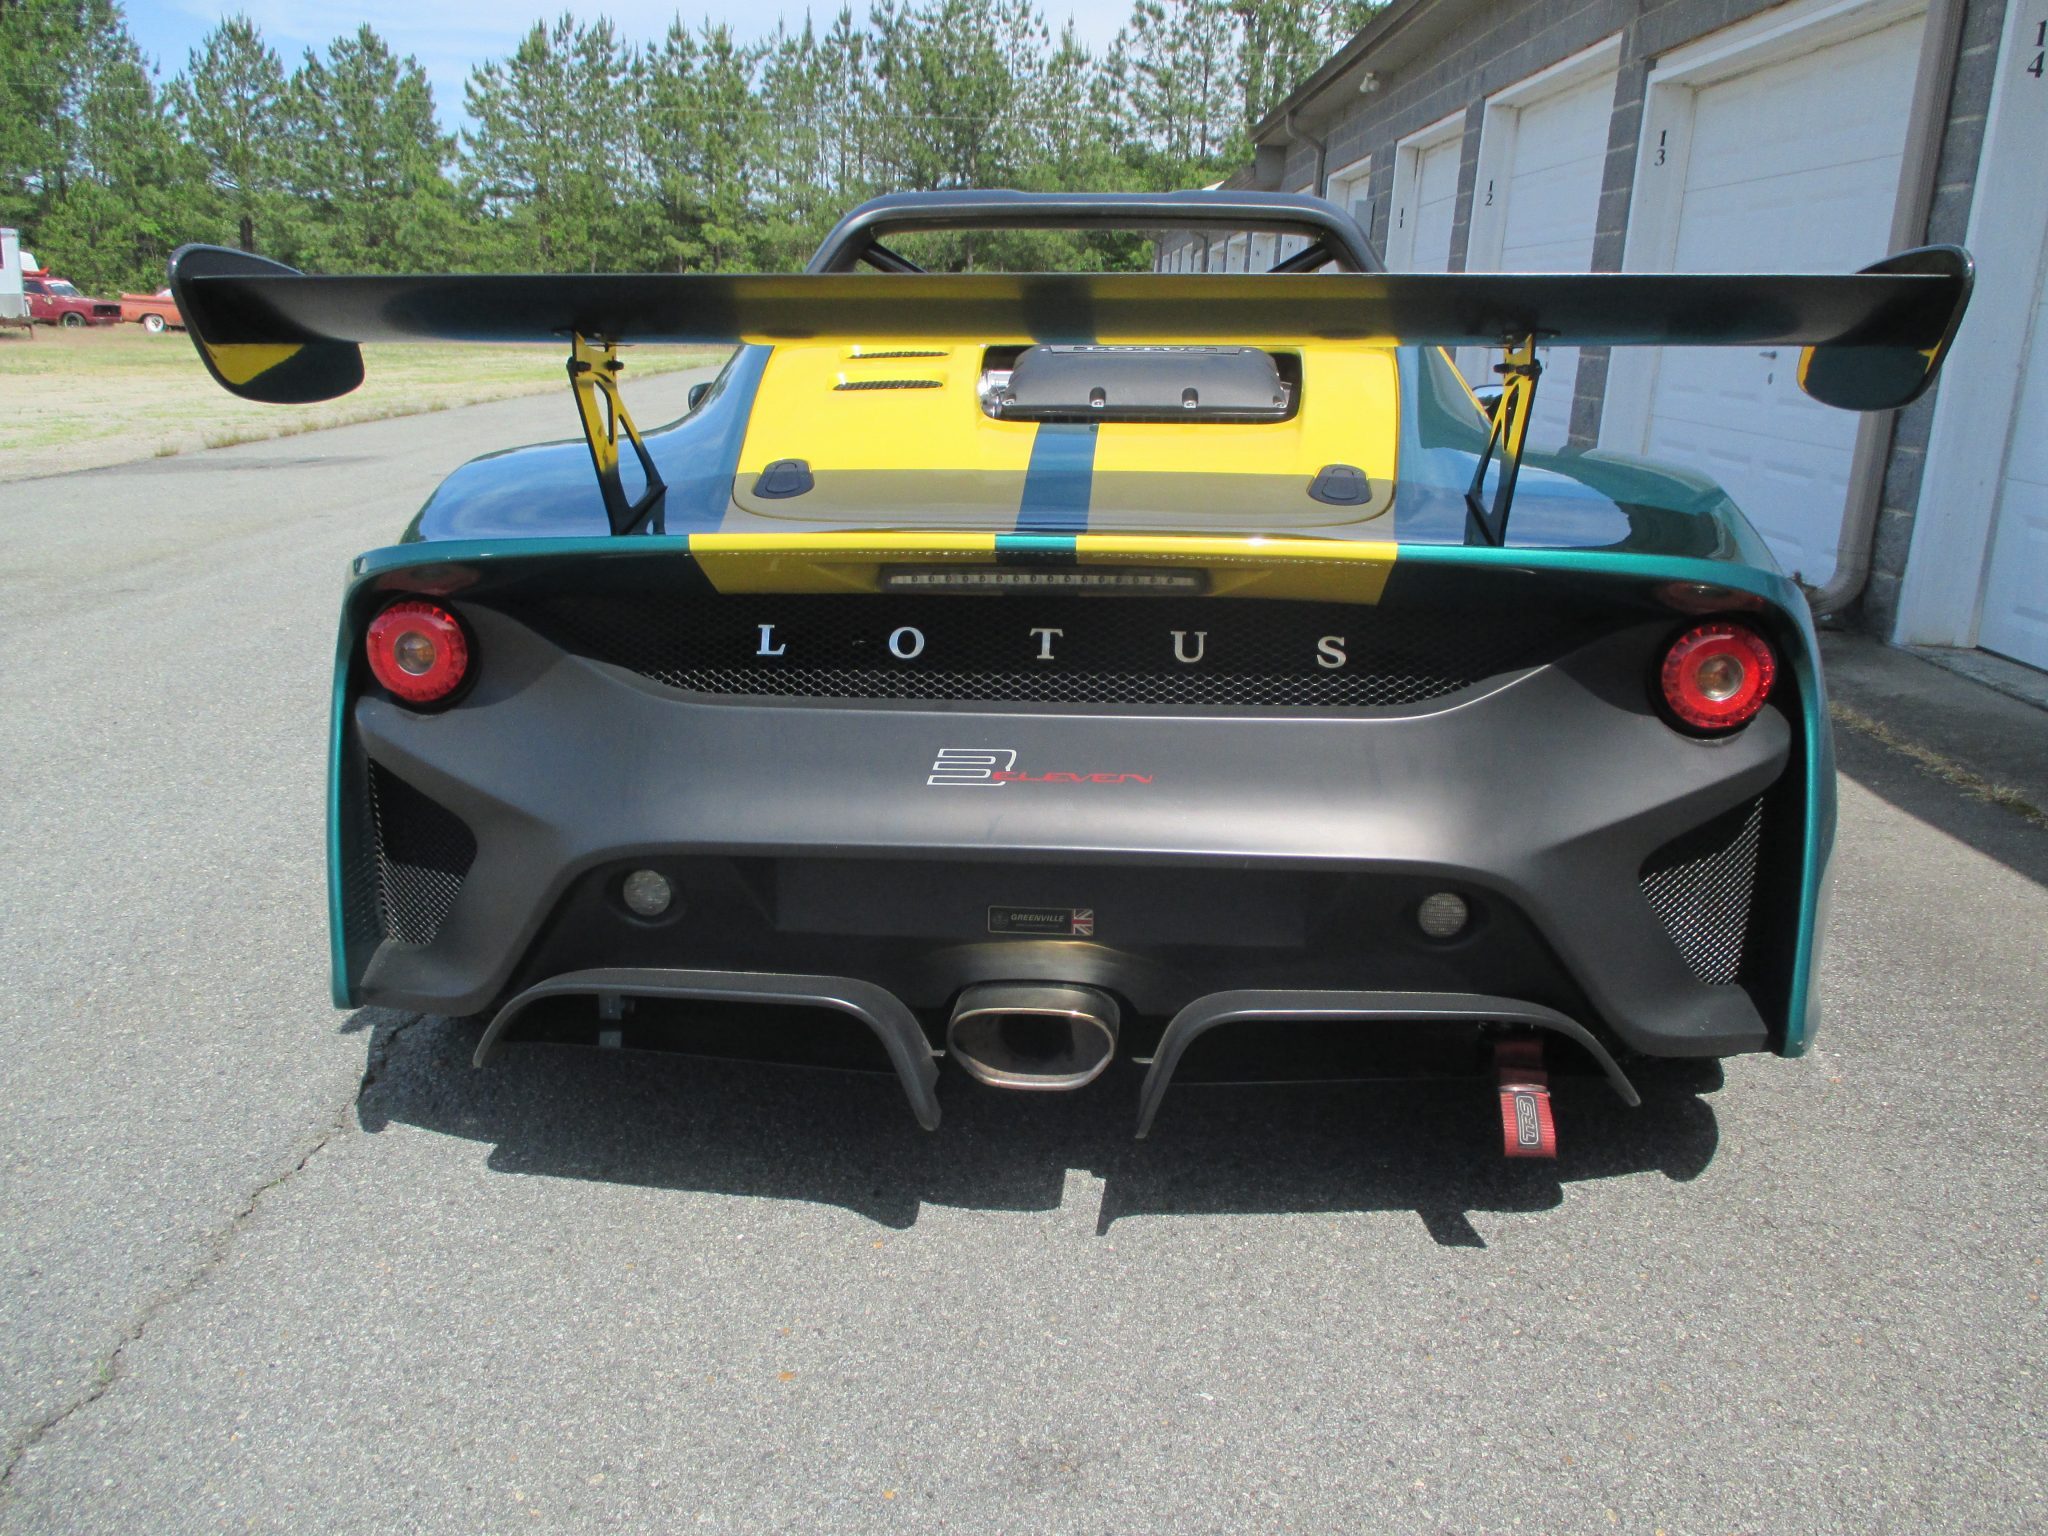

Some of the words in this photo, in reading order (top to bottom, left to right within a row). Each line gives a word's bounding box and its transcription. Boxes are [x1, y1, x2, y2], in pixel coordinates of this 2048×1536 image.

[756, 624, 1348, 668] LOTUS
[992, 770, 1154, 784] ELEVEN
[1010, 912, 1065, 923] GREENVILLE
[1519, 1098, 1536, 1142] TRS
